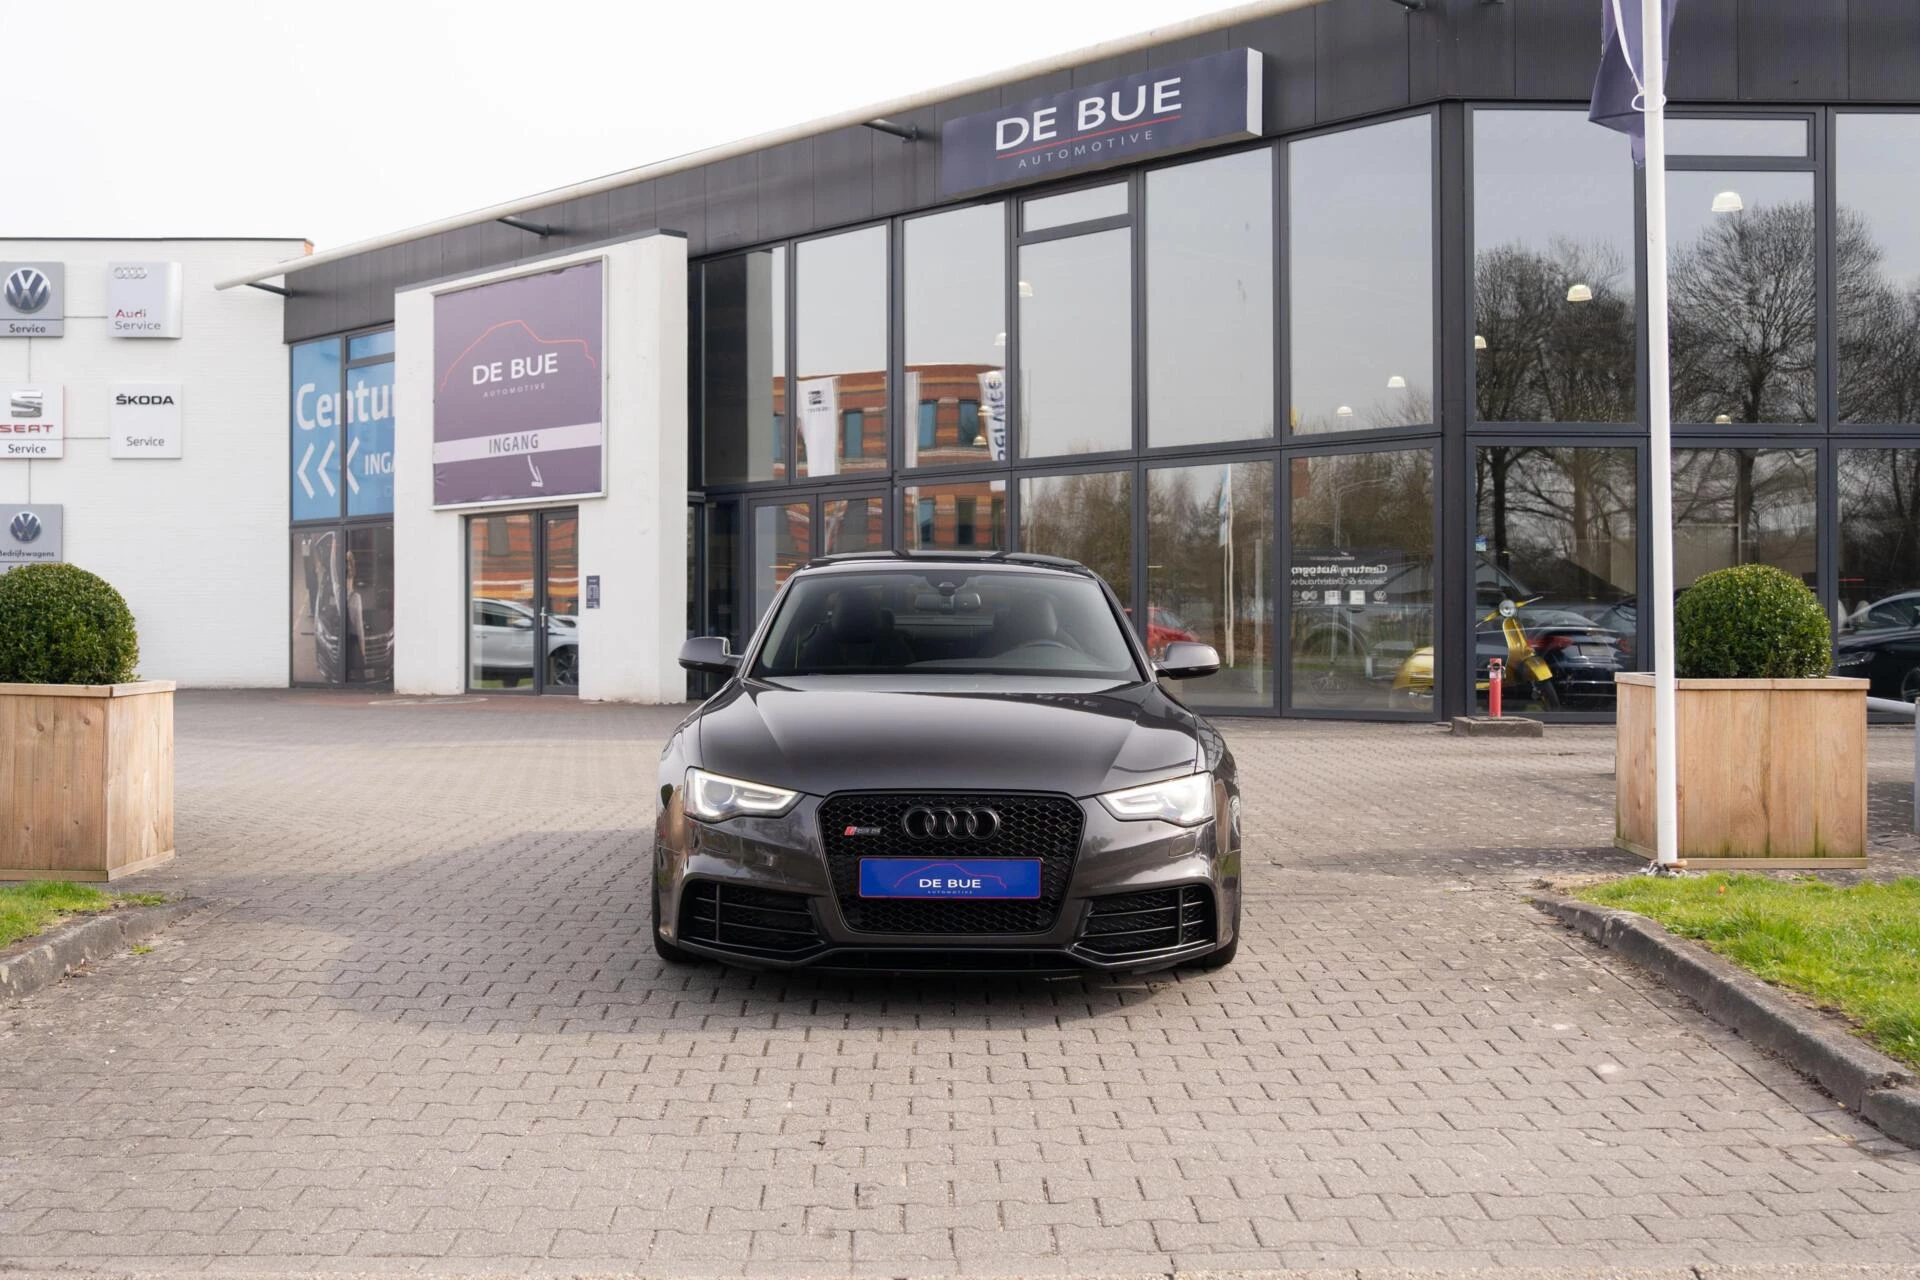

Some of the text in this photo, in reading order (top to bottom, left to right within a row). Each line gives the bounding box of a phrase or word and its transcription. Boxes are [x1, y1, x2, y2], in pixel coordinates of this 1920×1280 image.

[995, 77, 1182, 151] DE BUE
[1018, 129, 1153, 169] AUTOMOTIVE
[115, 308, 146, 318] Audi
[8, 323, 46, 333] Service
[114, 320, 161, 330] Service
[472, 352, 558, 385] DE BUE
[483, 382, 545, 398] AUTOMOTIVE
[115, 393, 175, 405] ŠKODA
[0, 424, 54, 433] SEAT
[126, 436, 165, 447] Service
[488, 433, 539, 455] INGANG
[8, 443, 47, 454] Service
[364, 451, 395, 475] ING
[919, 879, 982, 889] DE BUE
